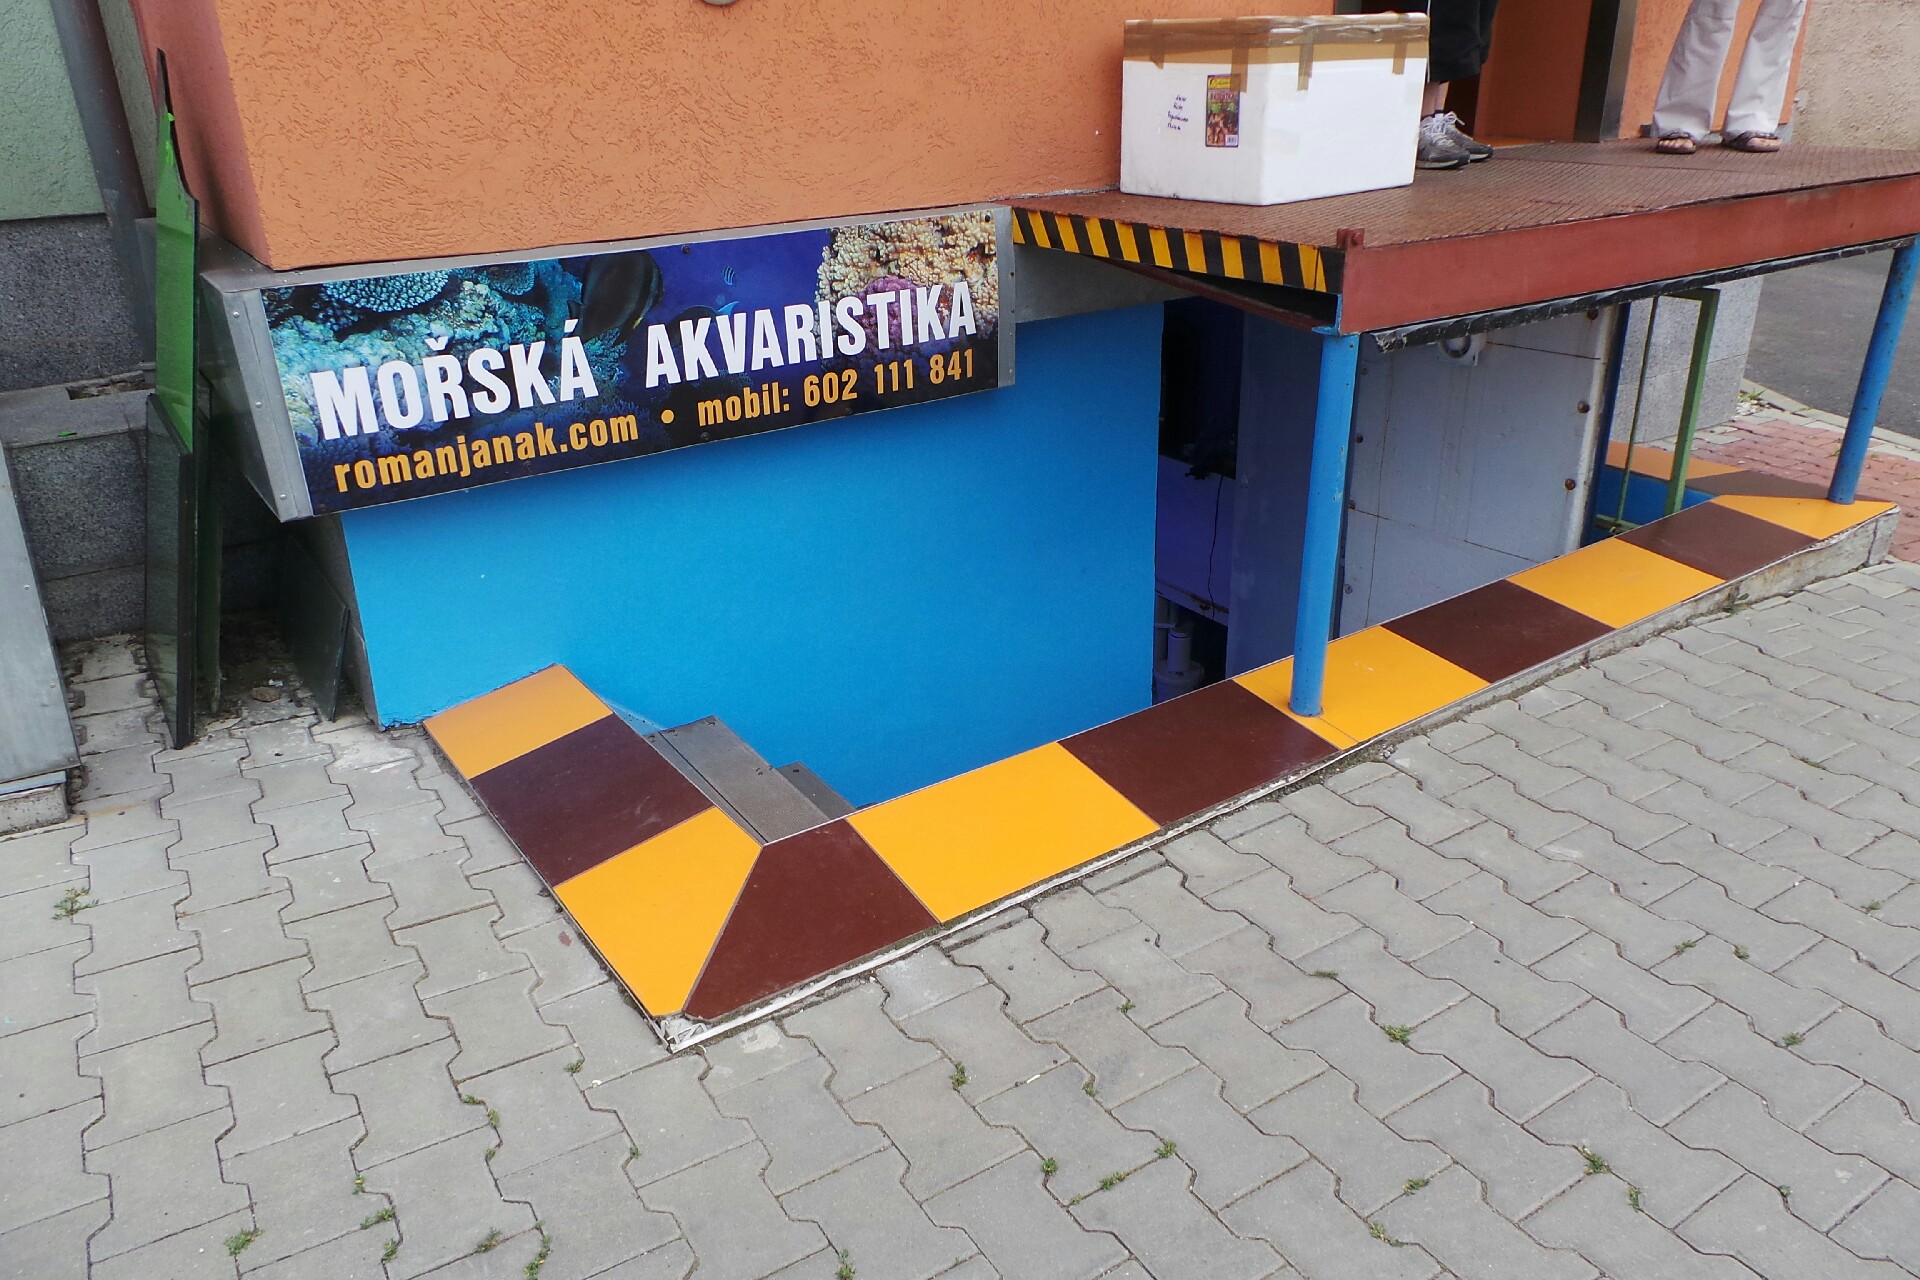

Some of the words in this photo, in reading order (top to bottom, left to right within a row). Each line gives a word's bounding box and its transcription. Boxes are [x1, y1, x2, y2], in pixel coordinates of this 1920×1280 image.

[310, 318, 600, 440] MOŘSKÁ
[645, 281, 977, 388] AKVARISTIKA
[334, 413, 639, 493] romanjanak.com
[697, 382, 790, 427] mobil:
[803, 368, 858, 408] 602
[875, 359, 914, 395] 111
[929, 348, 974, 385] 841
